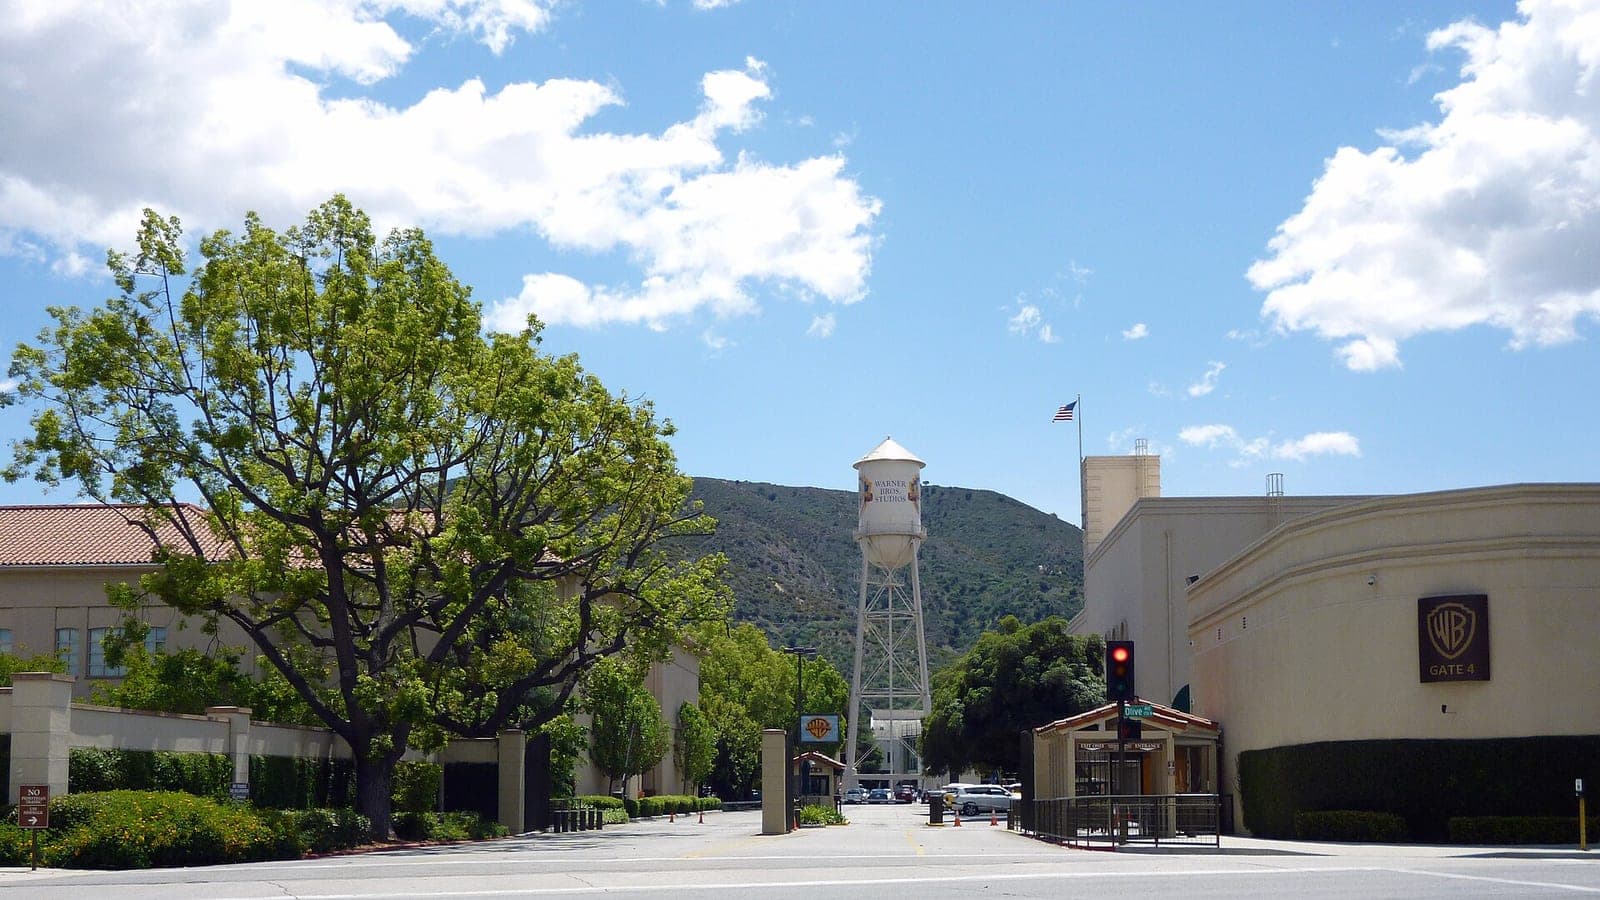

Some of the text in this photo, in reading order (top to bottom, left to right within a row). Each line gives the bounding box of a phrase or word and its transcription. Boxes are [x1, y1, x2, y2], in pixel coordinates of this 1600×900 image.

[874, 480, 906, 488] WARNER
[875, 495, 906, 503] STUDIOS
[1433, 610, 1467, 651] WB
[1429, 663, 1477, 676] GATE 4
[1125, 707, 1143, 716] Olive
